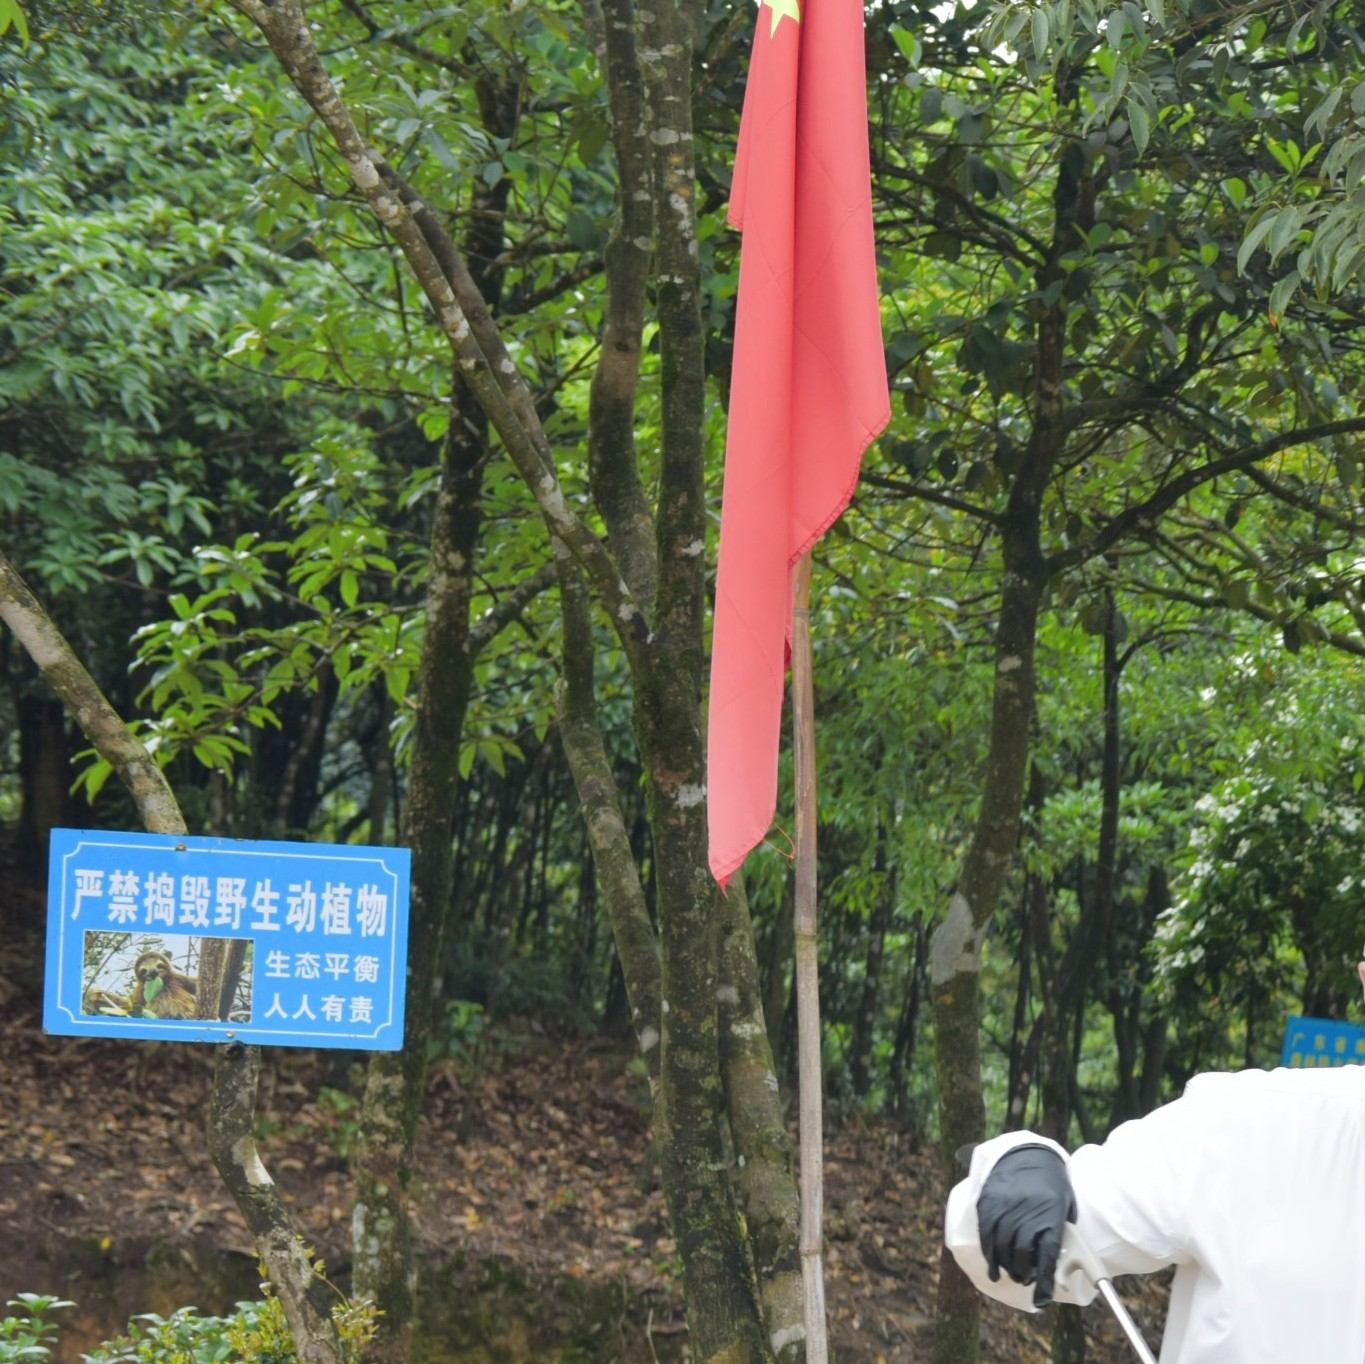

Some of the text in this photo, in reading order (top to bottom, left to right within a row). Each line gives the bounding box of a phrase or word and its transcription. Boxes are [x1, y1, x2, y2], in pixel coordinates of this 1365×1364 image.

[70, 868, 388, 938] 严禁捣毁野生动植物
[264, 950, 381, 983] 生态平衡
[263, 993, 374, 1024] 人人有责
